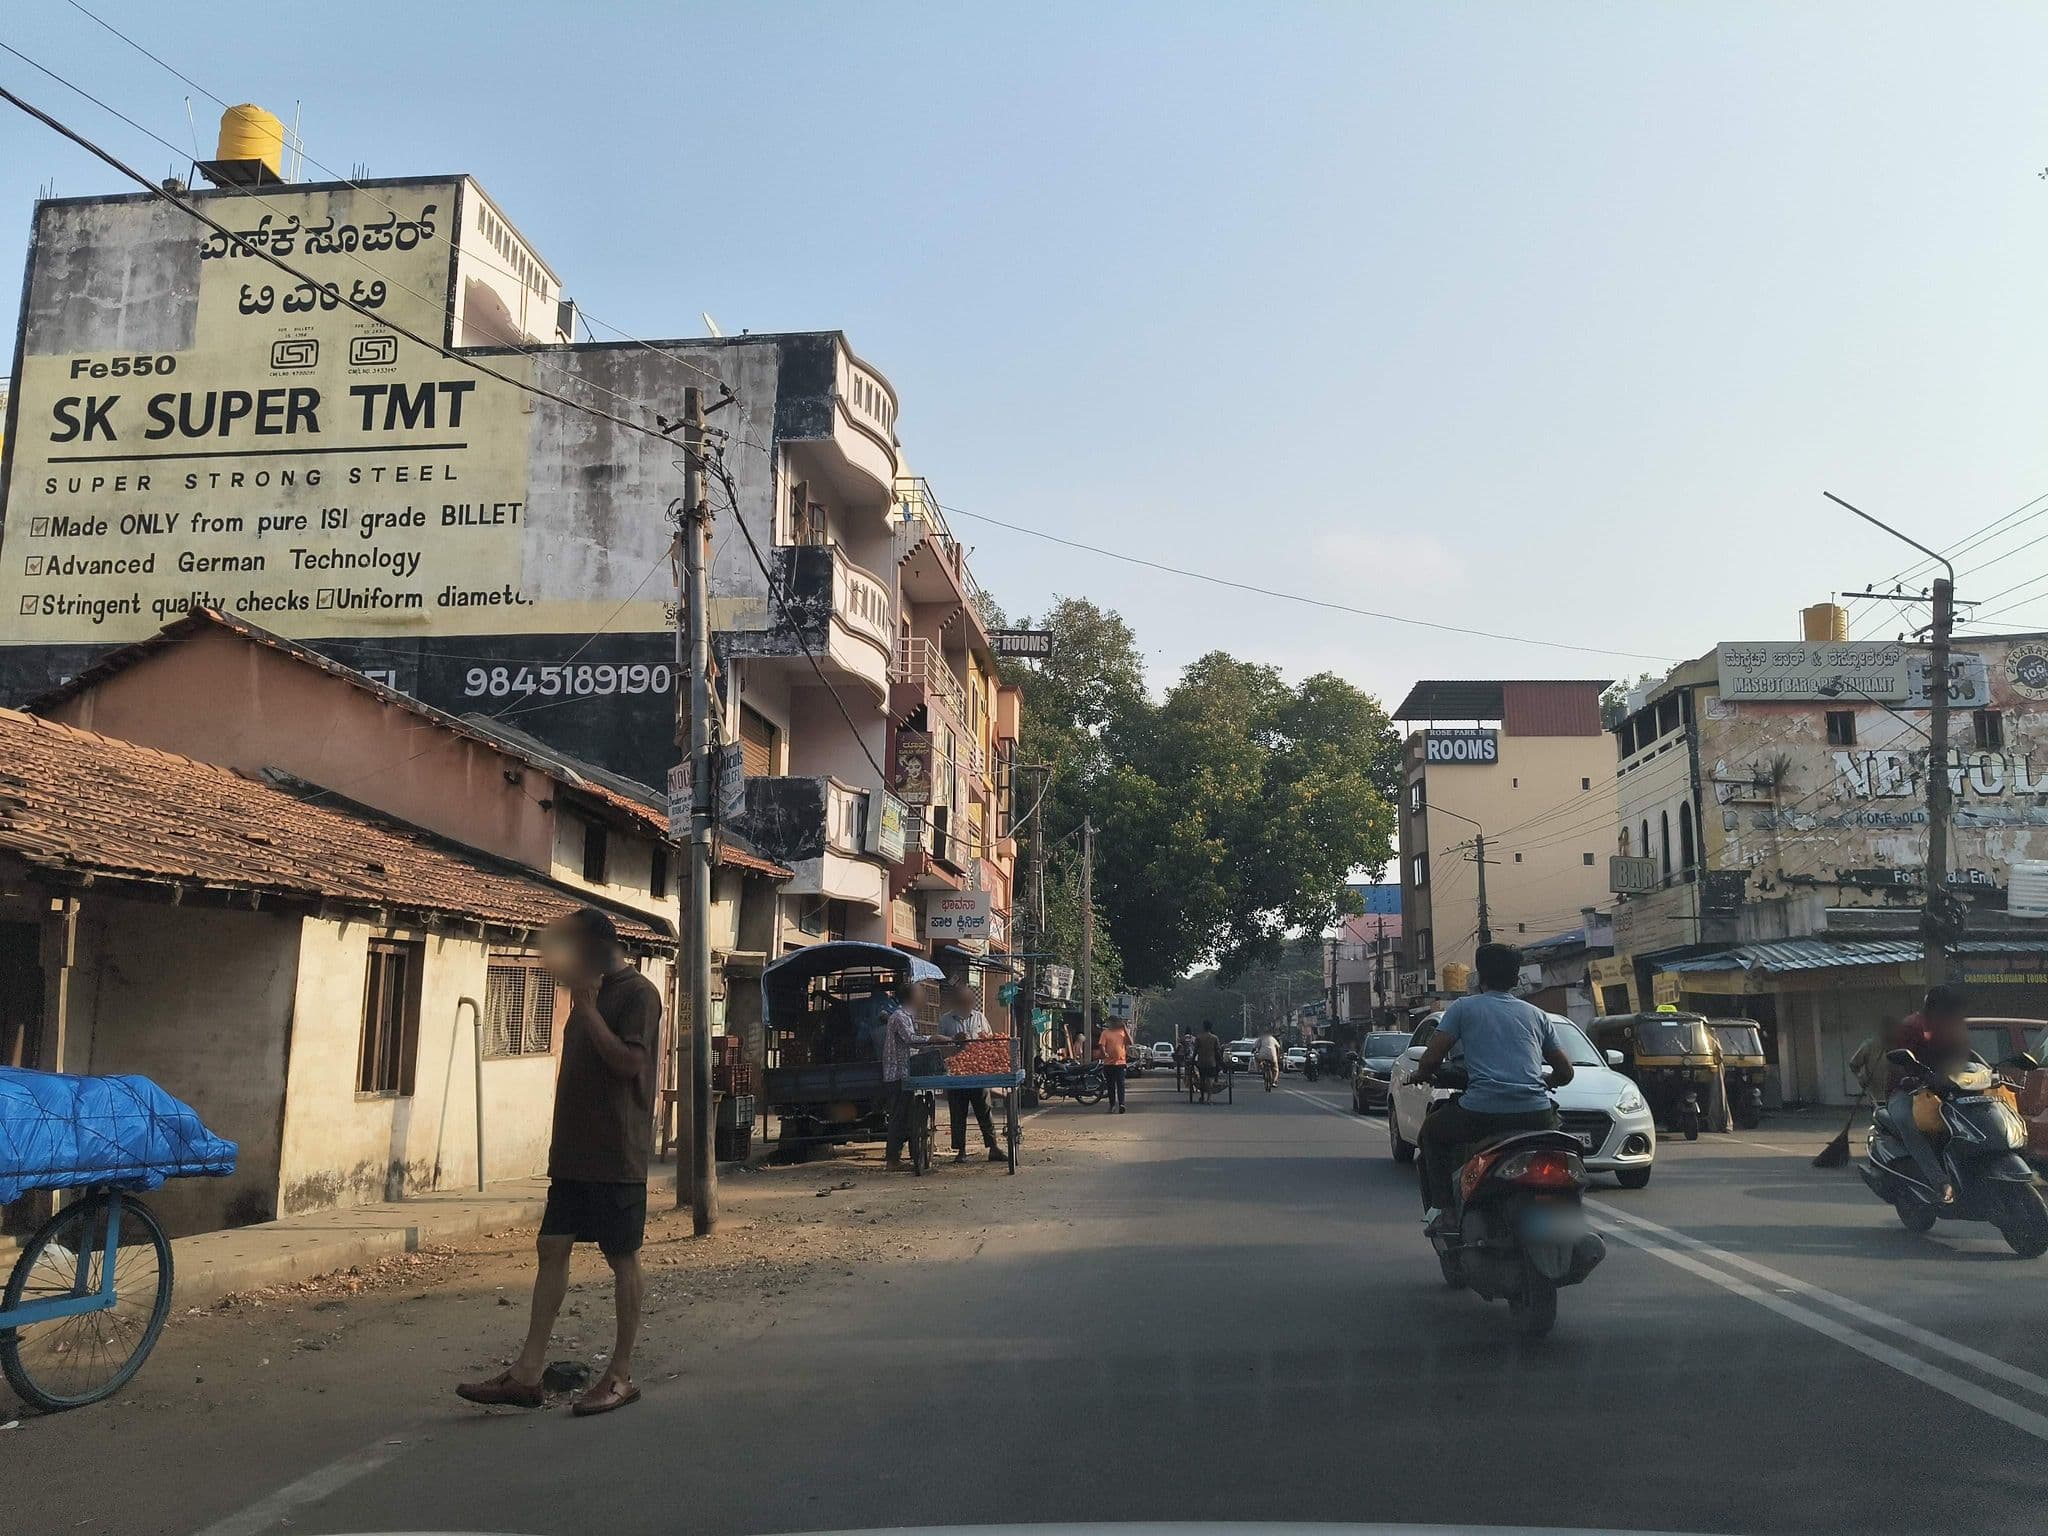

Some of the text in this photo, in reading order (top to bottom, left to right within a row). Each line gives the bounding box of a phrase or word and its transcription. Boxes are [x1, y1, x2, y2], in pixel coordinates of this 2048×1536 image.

[70, 354, 177, 379] Fe550
[50, 380, 476, 443] SK SUPER TMT
[46, 465, 458, 494] SUPER STRONG STEEL
[51, 503, 523, 541] Made ONLY from pure ISI grade BILLET
[46, 547, 421, 580] Advanced German Technology
[42, 593, 141, 624] Stringent
[152, 590, 225, 620] quality
[236, 590, 310, 611] checks
[337, 587, 423, 609] Uniform
[1002, 635, 1049, 652] ROOMS
[464, 664, 671, 698] 9845189190
[1733, 677, 1783, 693] MASCOT
[1784, 677, 1809, 693] BAR
[1820, 676, 1895, 693] RTAURANT
[1427, 738, 1496, 760] ROOMS
[1616, 861, 1655, 889] BAR
